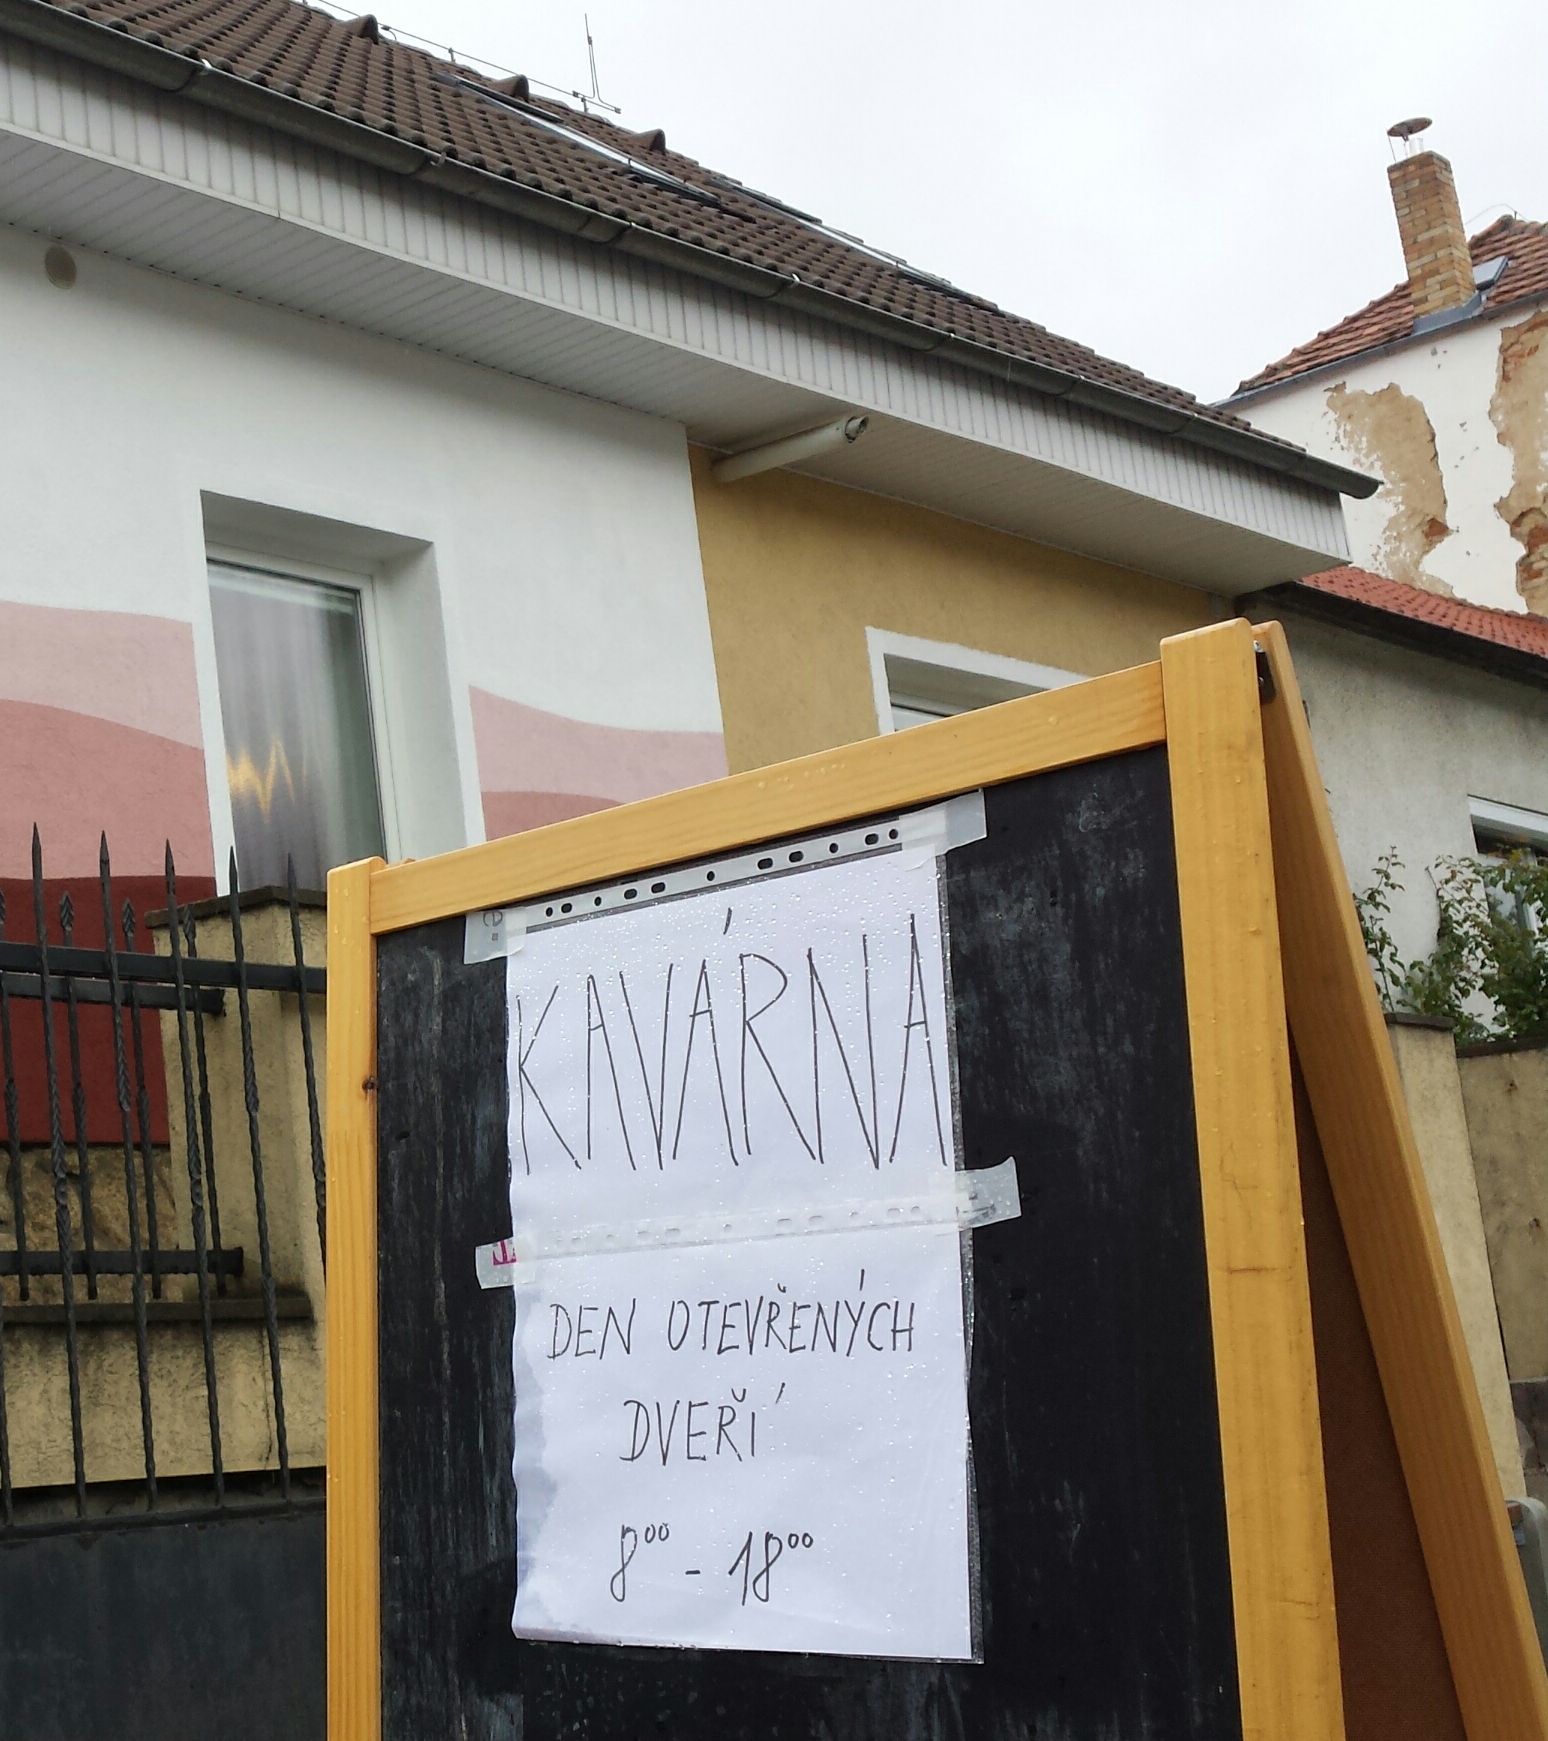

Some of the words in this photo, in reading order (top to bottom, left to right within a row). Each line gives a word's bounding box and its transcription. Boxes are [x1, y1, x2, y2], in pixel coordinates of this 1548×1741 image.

[515, 906, 948, 1176] KAVÁRNA
[546, 1297, 637, 1360] DEN
[666, 1268, 916, 1358] OTEVŘENÝCH
[618, 1382, 786, 1466] DVEŘÍ
